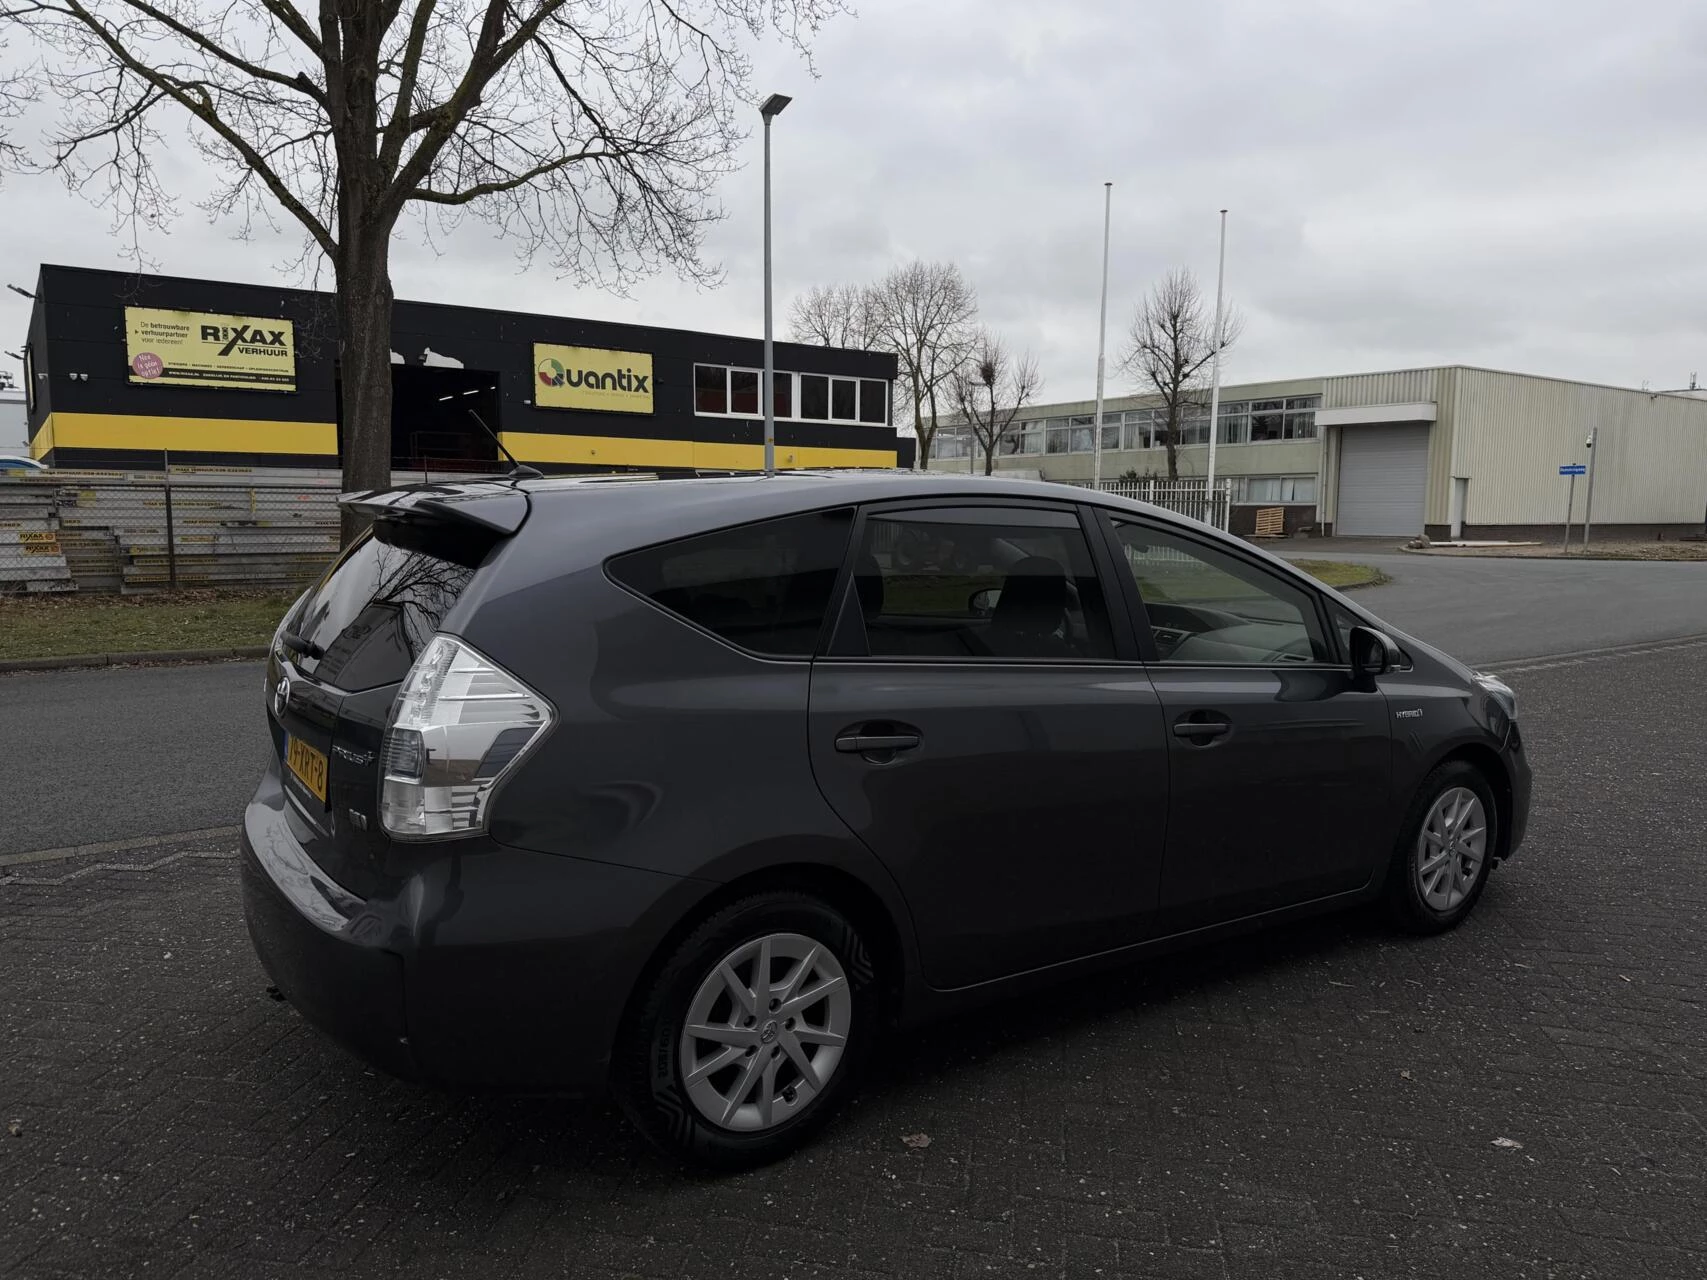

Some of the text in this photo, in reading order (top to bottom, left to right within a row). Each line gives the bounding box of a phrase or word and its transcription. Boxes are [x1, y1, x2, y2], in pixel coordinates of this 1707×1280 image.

[150, 322, 190, 332] betrouwbare
[141, 329, 188, 338] verhuurpartner
[238, 346, 288, 357] VERHUUR
